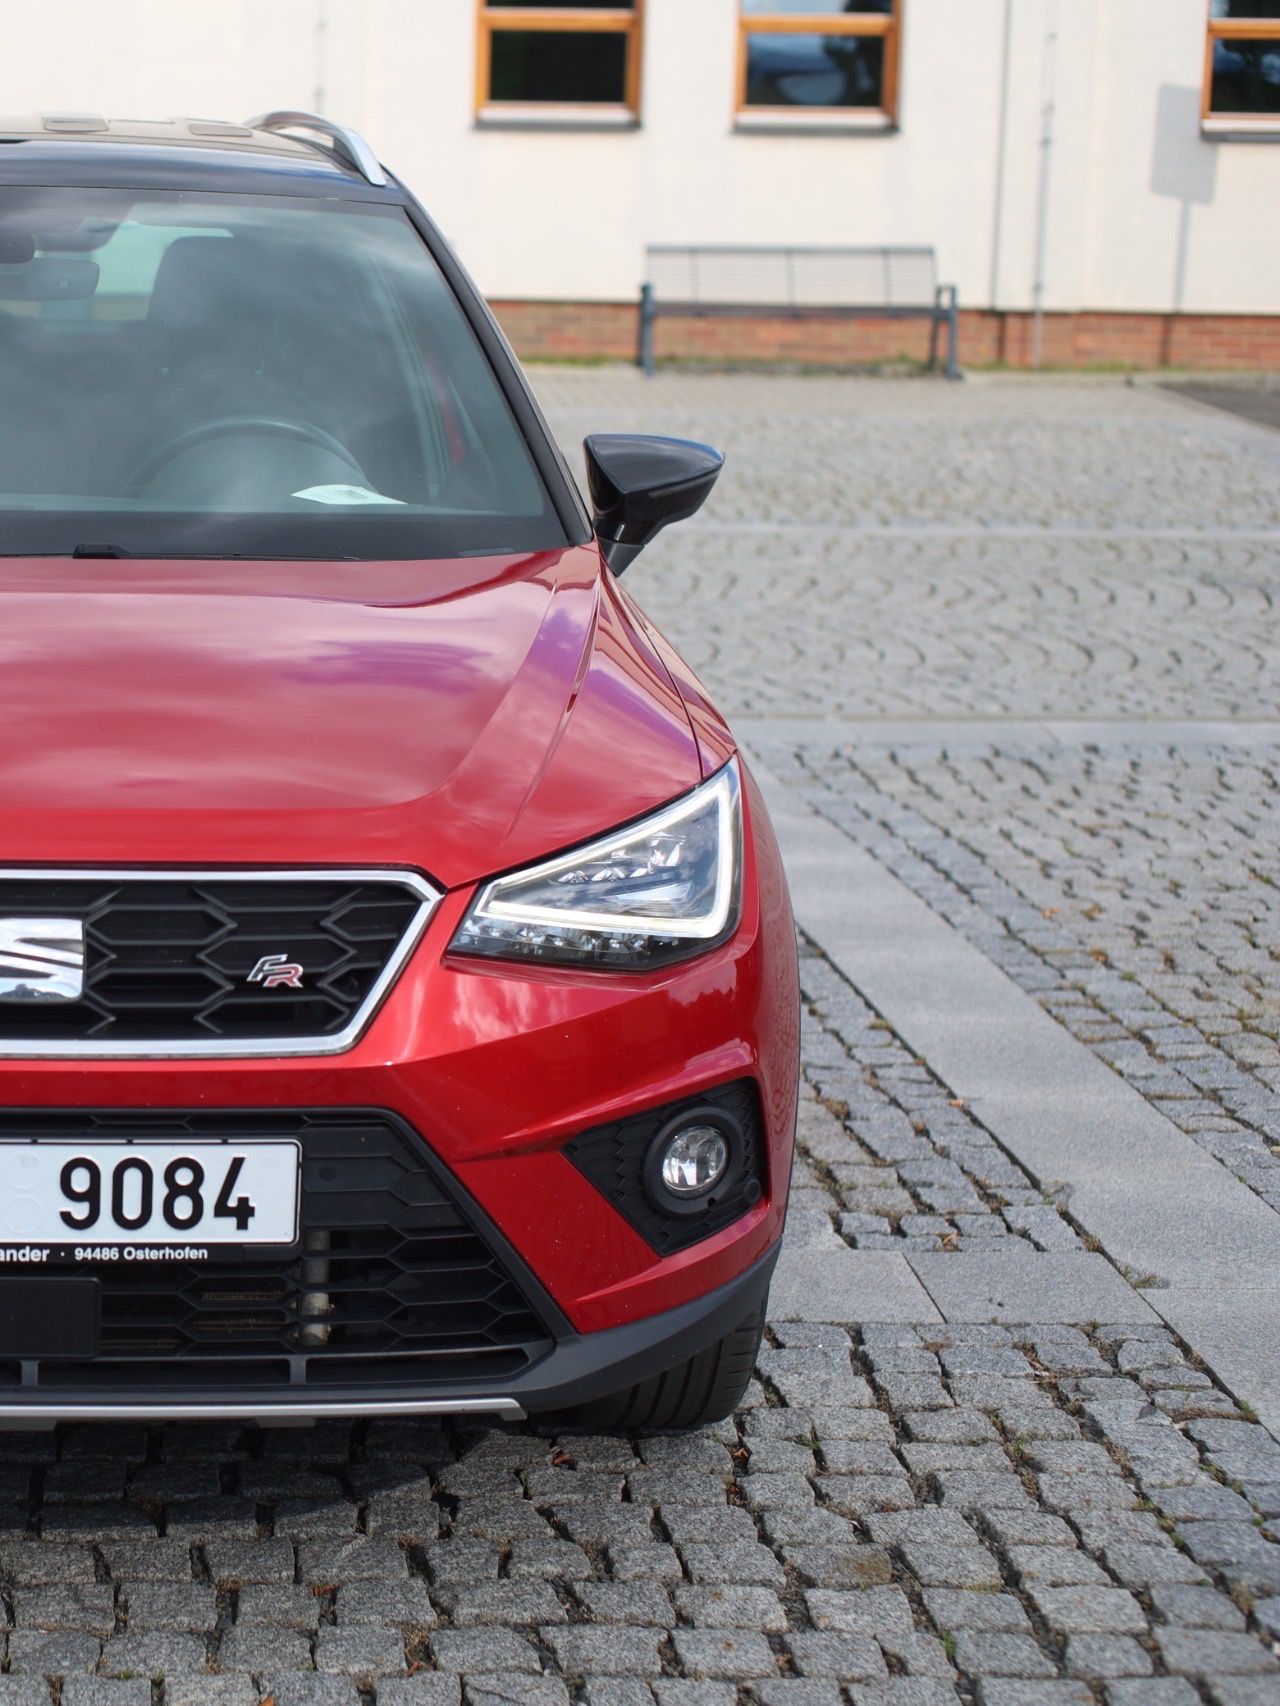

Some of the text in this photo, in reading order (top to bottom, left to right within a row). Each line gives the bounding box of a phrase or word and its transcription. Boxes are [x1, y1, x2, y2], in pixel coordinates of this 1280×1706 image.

[246, 953, 304, 988] FR
[59, 1157, 256, 1231] 9084
[74, 1247, 119, 1261] 94486
[123, 1246, 208, 1261] Osterhofen
